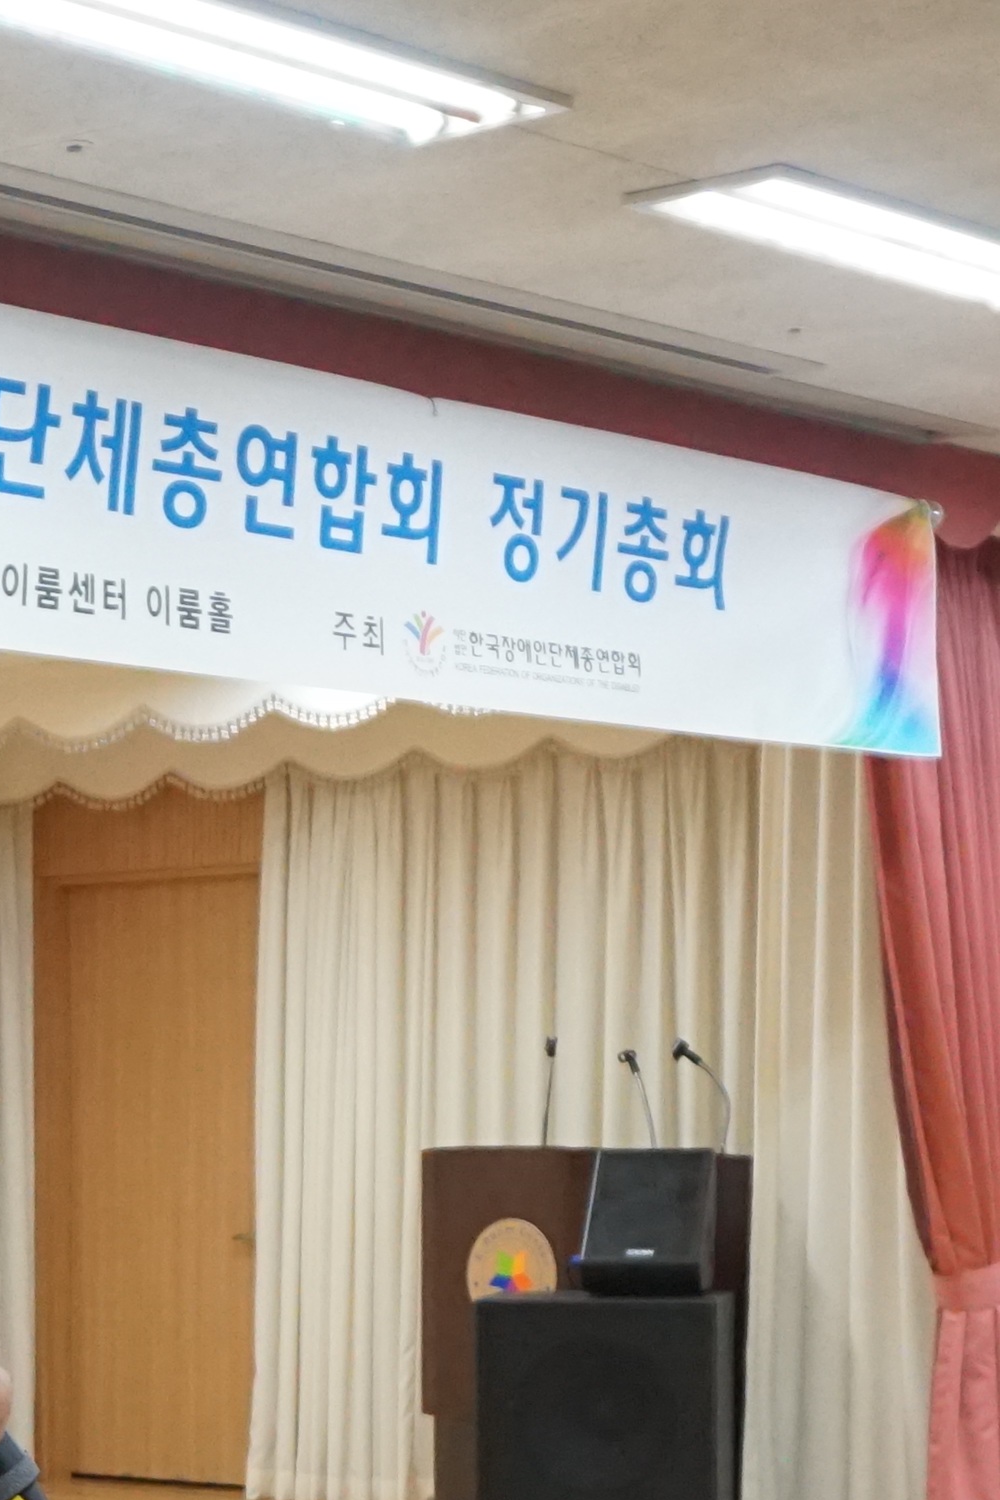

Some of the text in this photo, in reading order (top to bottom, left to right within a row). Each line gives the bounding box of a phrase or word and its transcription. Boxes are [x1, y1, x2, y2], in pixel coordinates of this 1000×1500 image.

[490, 472, 730, 610] 정기총회
[1, 562, 127, 620] 이룸센터
[146, 584, 234, 635] 이룸홀
[332, 611, 385, 656] 주최
[468, 631, 642, 678] 한국장애인단체총연합회
